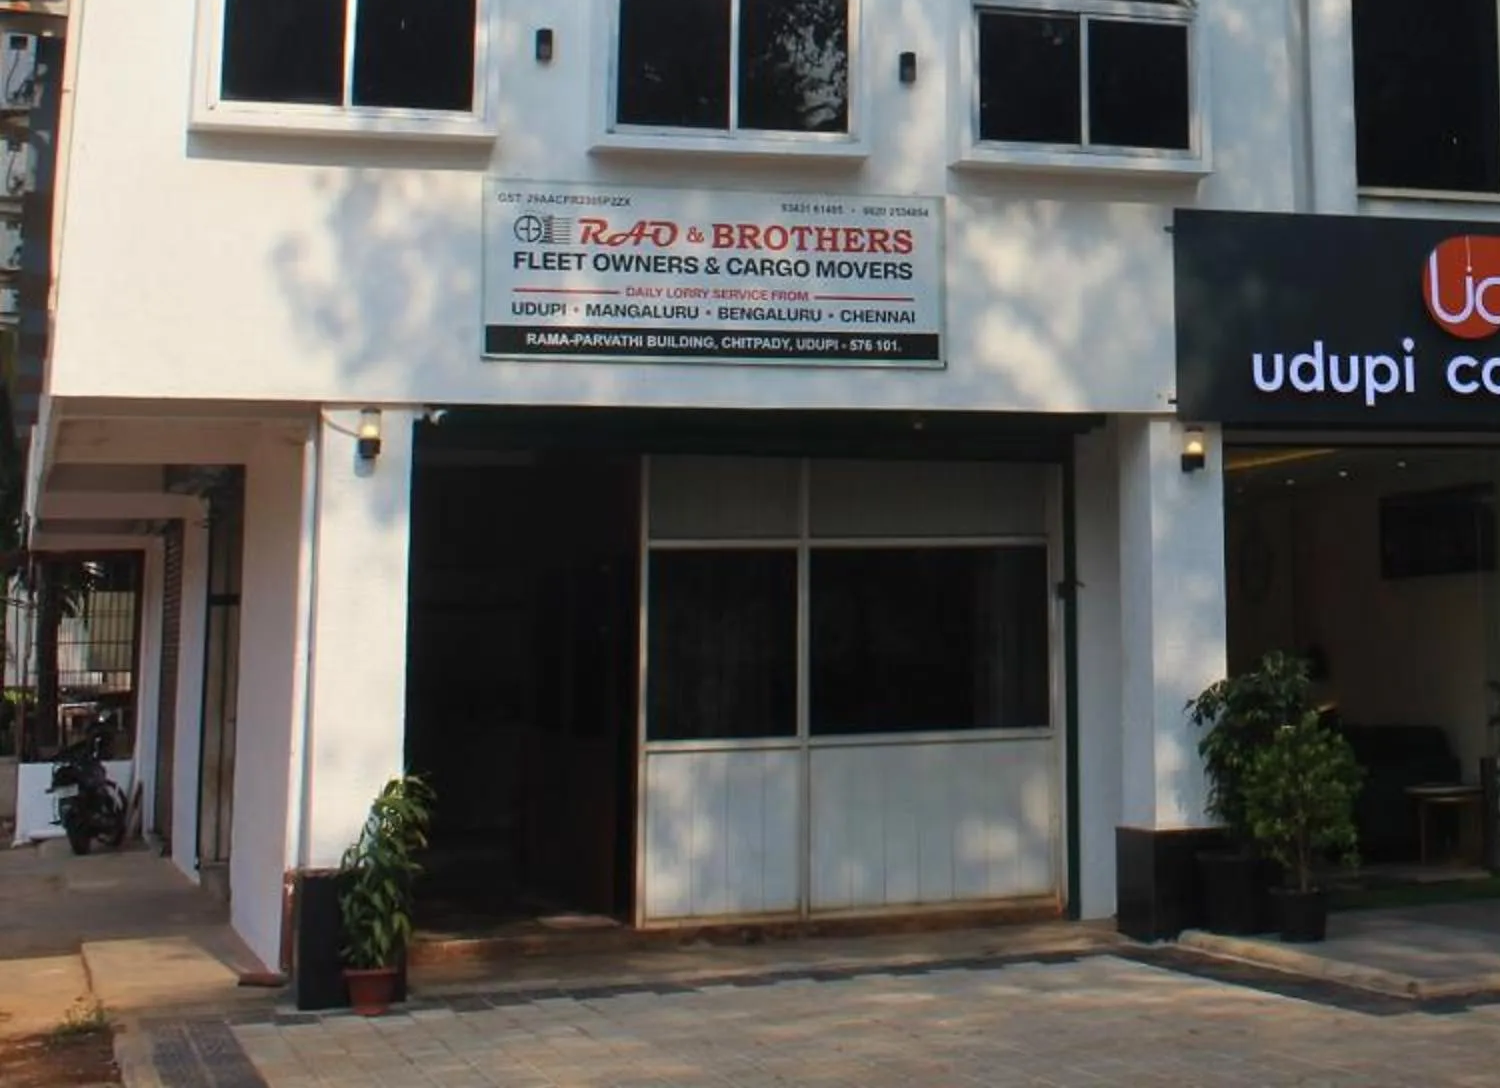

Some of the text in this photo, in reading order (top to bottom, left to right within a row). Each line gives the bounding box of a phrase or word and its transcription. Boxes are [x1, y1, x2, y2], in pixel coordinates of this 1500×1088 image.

[577, 216, 914, 255] RAO & BROTHERS
[513, 250, 914, 281] FLEET OWNERS & CARGO MOVERS
[624, 286, 810, 302] DAILY LORRY SERVICE FROM
[511, 301, 916, 324] UDUPI MANGALURU BENGALURU CHENNAI
[526, 332, 644, 348] RAMA-PARVATHI
[647, 334, 719, 351] BUILDING,
[721, 336, 794, 352] CHITPADY,
[796, 338, 839, 351] UDUPI
[849, 339, 873, 352] 576
[1252, 336, 1416, 407] udupi
